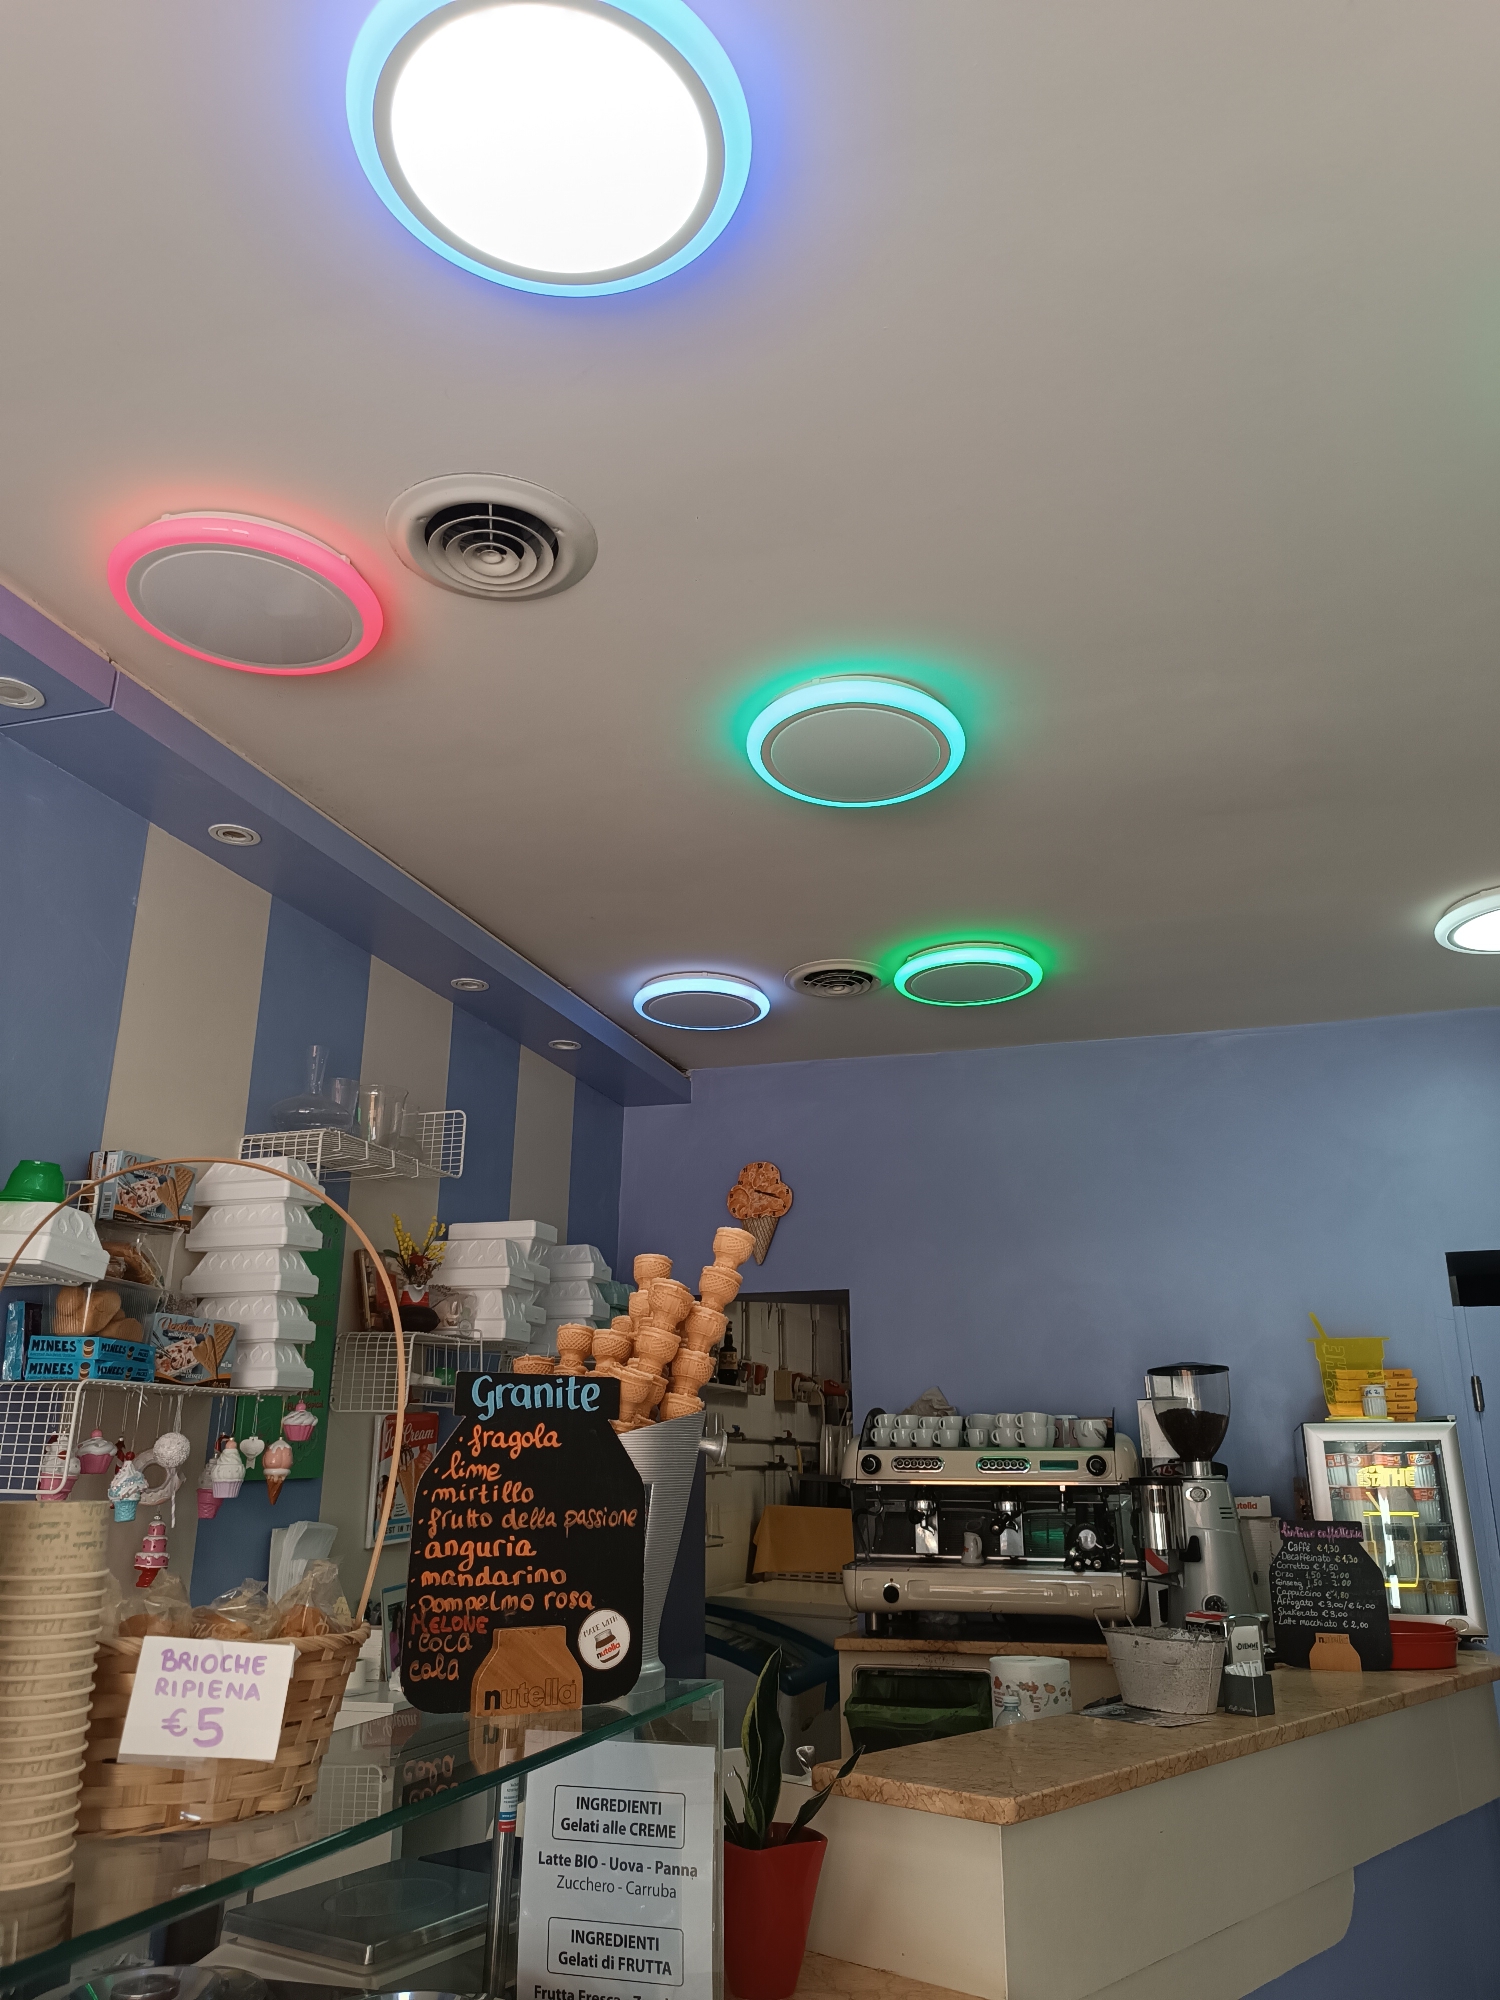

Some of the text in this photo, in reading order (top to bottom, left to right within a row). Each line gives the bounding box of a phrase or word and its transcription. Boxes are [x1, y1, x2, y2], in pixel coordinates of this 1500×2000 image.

[31, 1339, 77, 1353] MINEES
[101, 1342, 126, 1355] MINEES
[28, 1362, 74, 1375] MINEES
[97, 1365, 124, 1376] MINEES
[471, 1375, 600, 1421] Granite
[403, 1423, 434, 1444] Cream
[467, 1422, 562, 1460] fragola
[441, 1450, 502, 1481] lime
[431, 1480, 534, 1504] mirtillo
[427, 1509, 494, 1539] frutto
[501, 1507, 557, 1531] della
[564, 1506, 638, 1539] passione
[424, 1535, 537, 1572] anguria
[1281, 1551, 1331, 1562] Decaffeinato
[1287, 1541, 1311, 1552] Caffè
[421, 1565, 567, 1588] mandarino
[417, 1590, 595, 1622] pompelmo rosa
[161, 1648, 268, 1676] BRIOCHE
[596, 1642, 621, 1659] nutella
[409, 1653, 460, 1682] cola
[154, 1677, 261, 1701] RIPIENA
[483, 1677, 577, 1711] nutella
[576, 1796, 662, 1815] INGREDIENTI
[561, 1817, 676, 1839] Gelati alle CREME
[538, 1851, 572, 1867] Latte
[574, 1854, 599, 1869] BIO
[609, 1857, 644, 1873] Uova
[655, 1861, 698, 1878] Panna
[557, 1875, 615, 1893] Zucchero
[626, 1881, 677, 1899] Carruba
[571, 1929, 659, 1951] INGREDIENTI
[558, 1951, 672, 1976] Gelati di FRUTTA
[534, 1985, 575, 2000] Frutta
